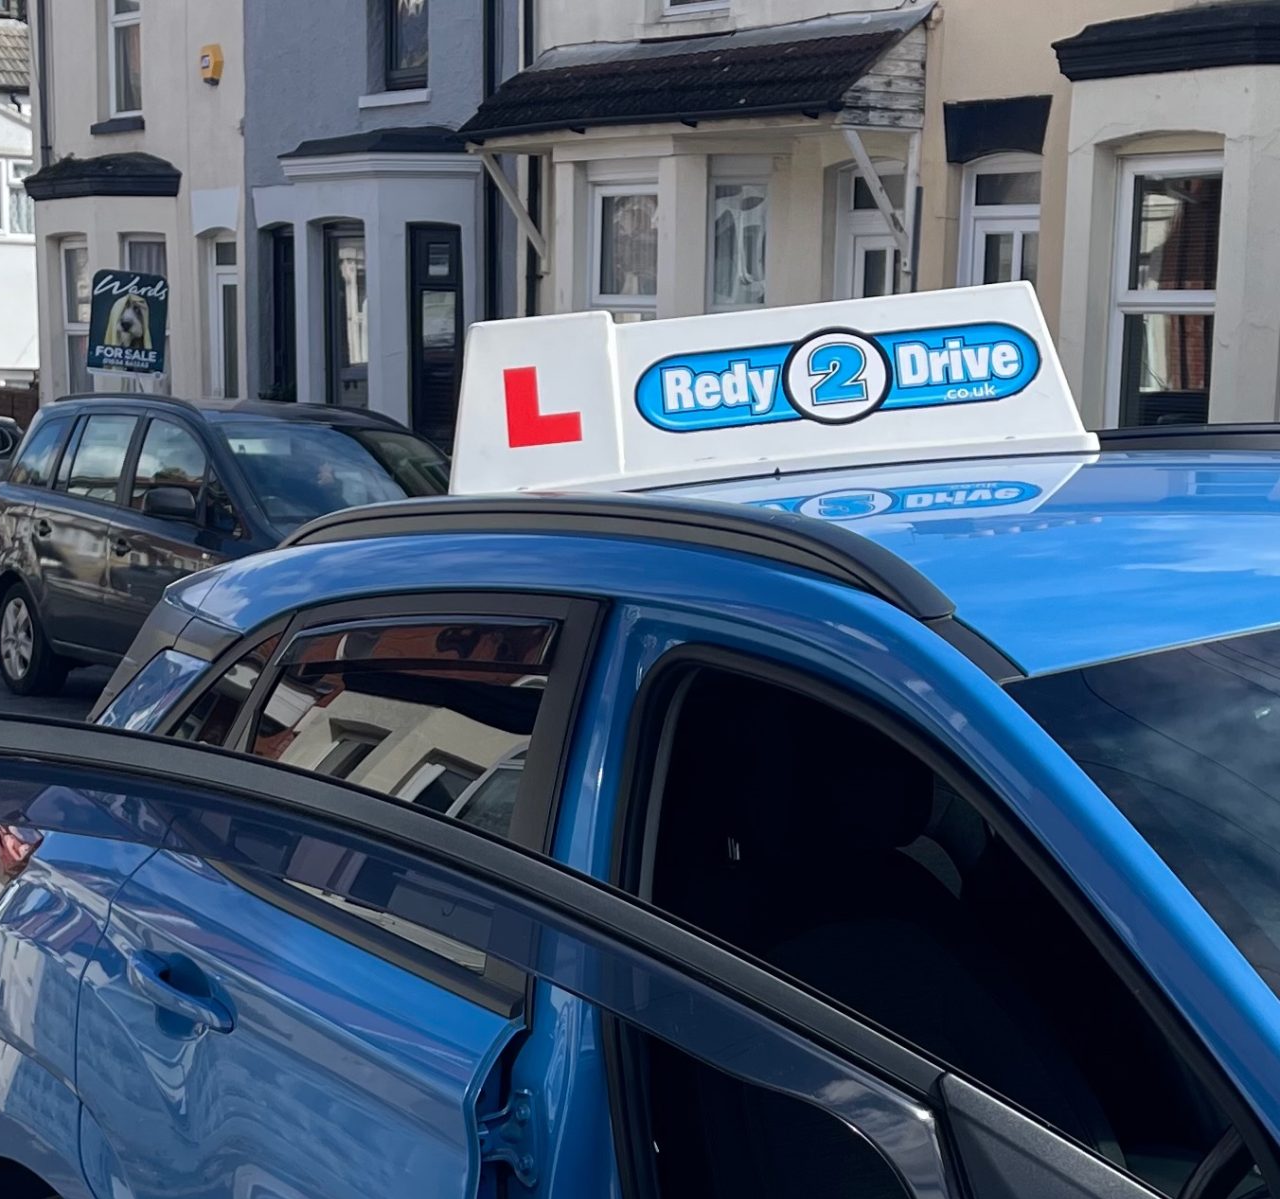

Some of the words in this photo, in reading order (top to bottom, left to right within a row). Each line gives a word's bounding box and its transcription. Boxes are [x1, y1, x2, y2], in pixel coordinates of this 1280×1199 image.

[93, 274, 168, 300] Wards
[95, 345, 123, 359] FOR
[124, 349, 158, 363] SALE
[662, 360, 779, 414] Redy
[807, 341, 869, 406] 2
[894, 337, 1021, 388] Drive
[943, 383, 997, 401] .co.uk
[503, 366, 582, 448] L
